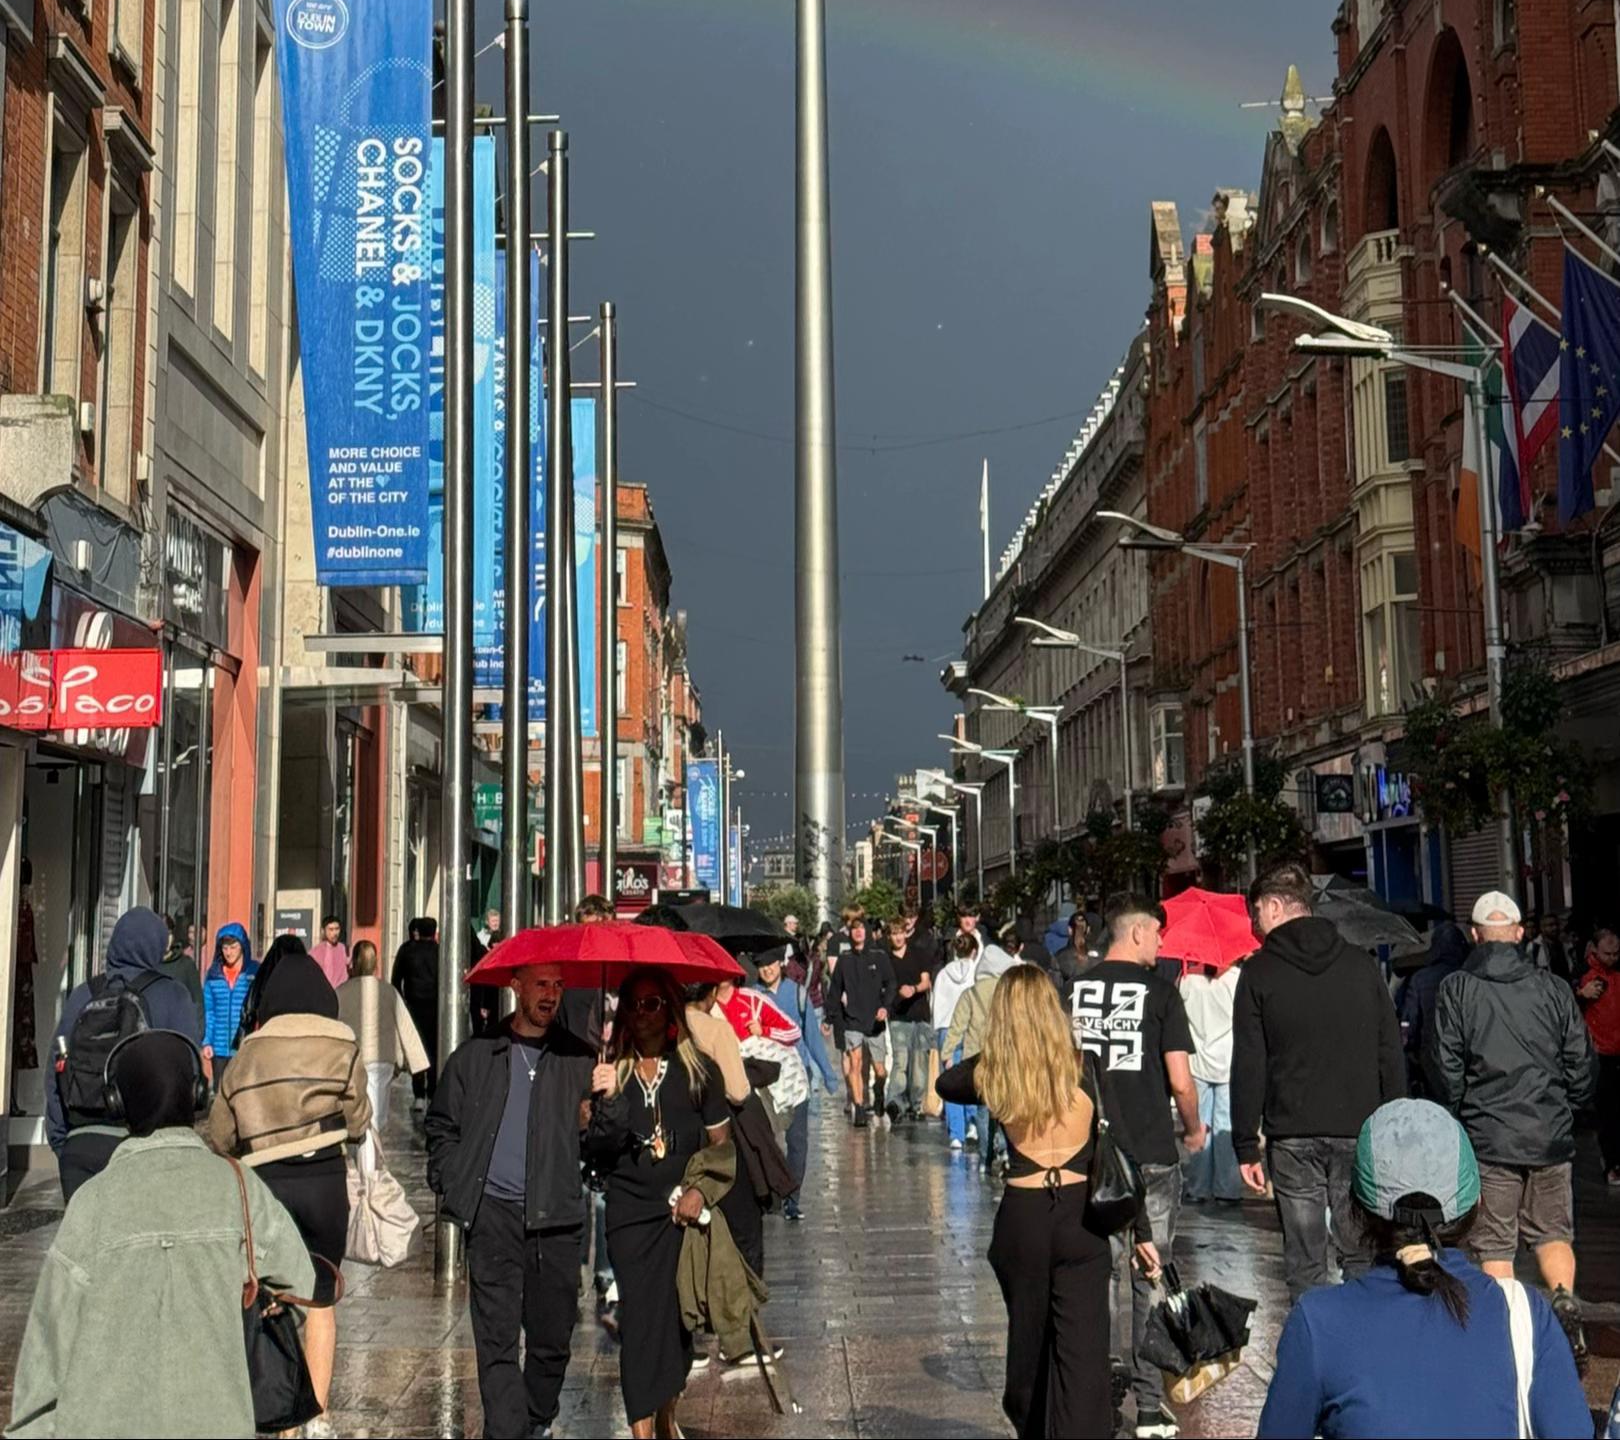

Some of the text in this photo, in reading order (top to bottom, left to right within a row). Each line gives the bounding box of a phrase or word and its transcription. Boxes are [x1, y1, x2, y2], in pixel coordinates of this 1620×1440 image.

[299, 21, 335, 33] TOWN
[353, 138, 388, 415] CHANEL & DKNY
[386, 137, 423, 421] SOCKS & JOCKS,
[328, 446, 421, 459] MORE CHOICE
[329, 462, 403, 473] AND VALUE
[328, 477, 374, 489] AT THE
[328, 491, 408, 504] OF THE CITY
[328, 525, 421, 538] Dublin-One.ie
[327, 546, 404, 558] #dublinone
[1072, 1018, 1141, 1031] GIVENCHY
